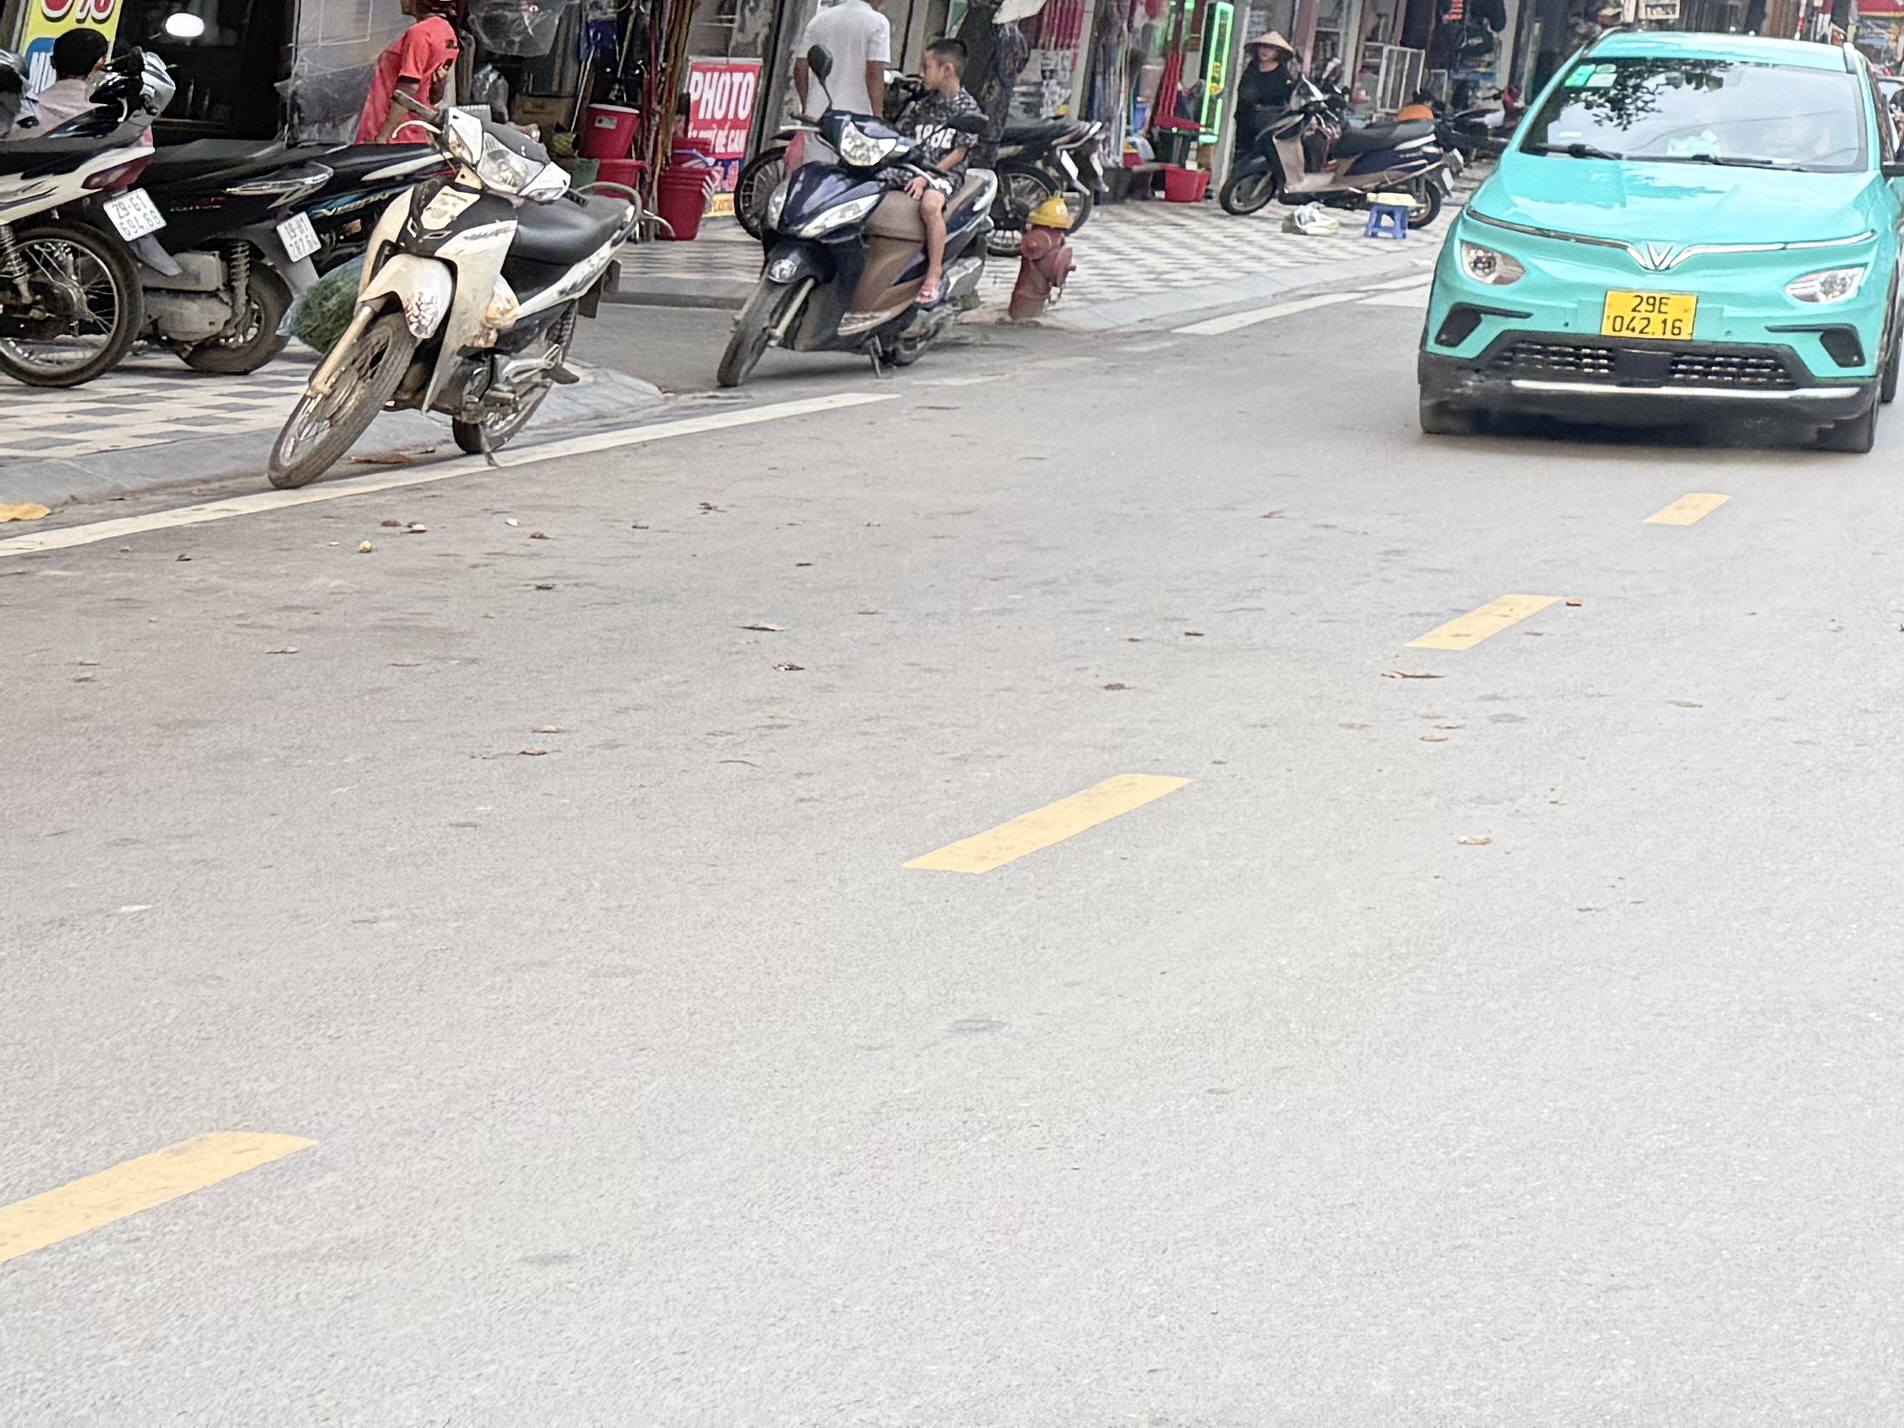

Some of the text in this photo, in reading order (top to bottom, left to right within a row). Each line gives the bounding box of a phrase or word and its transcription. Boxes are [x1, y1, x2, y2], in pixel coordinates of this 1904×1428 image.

[689, 71, 755, 121] PHOTO
[1631, 295, 1669, 315] 29E
[1612, 316, 1683, 337] 042.16
